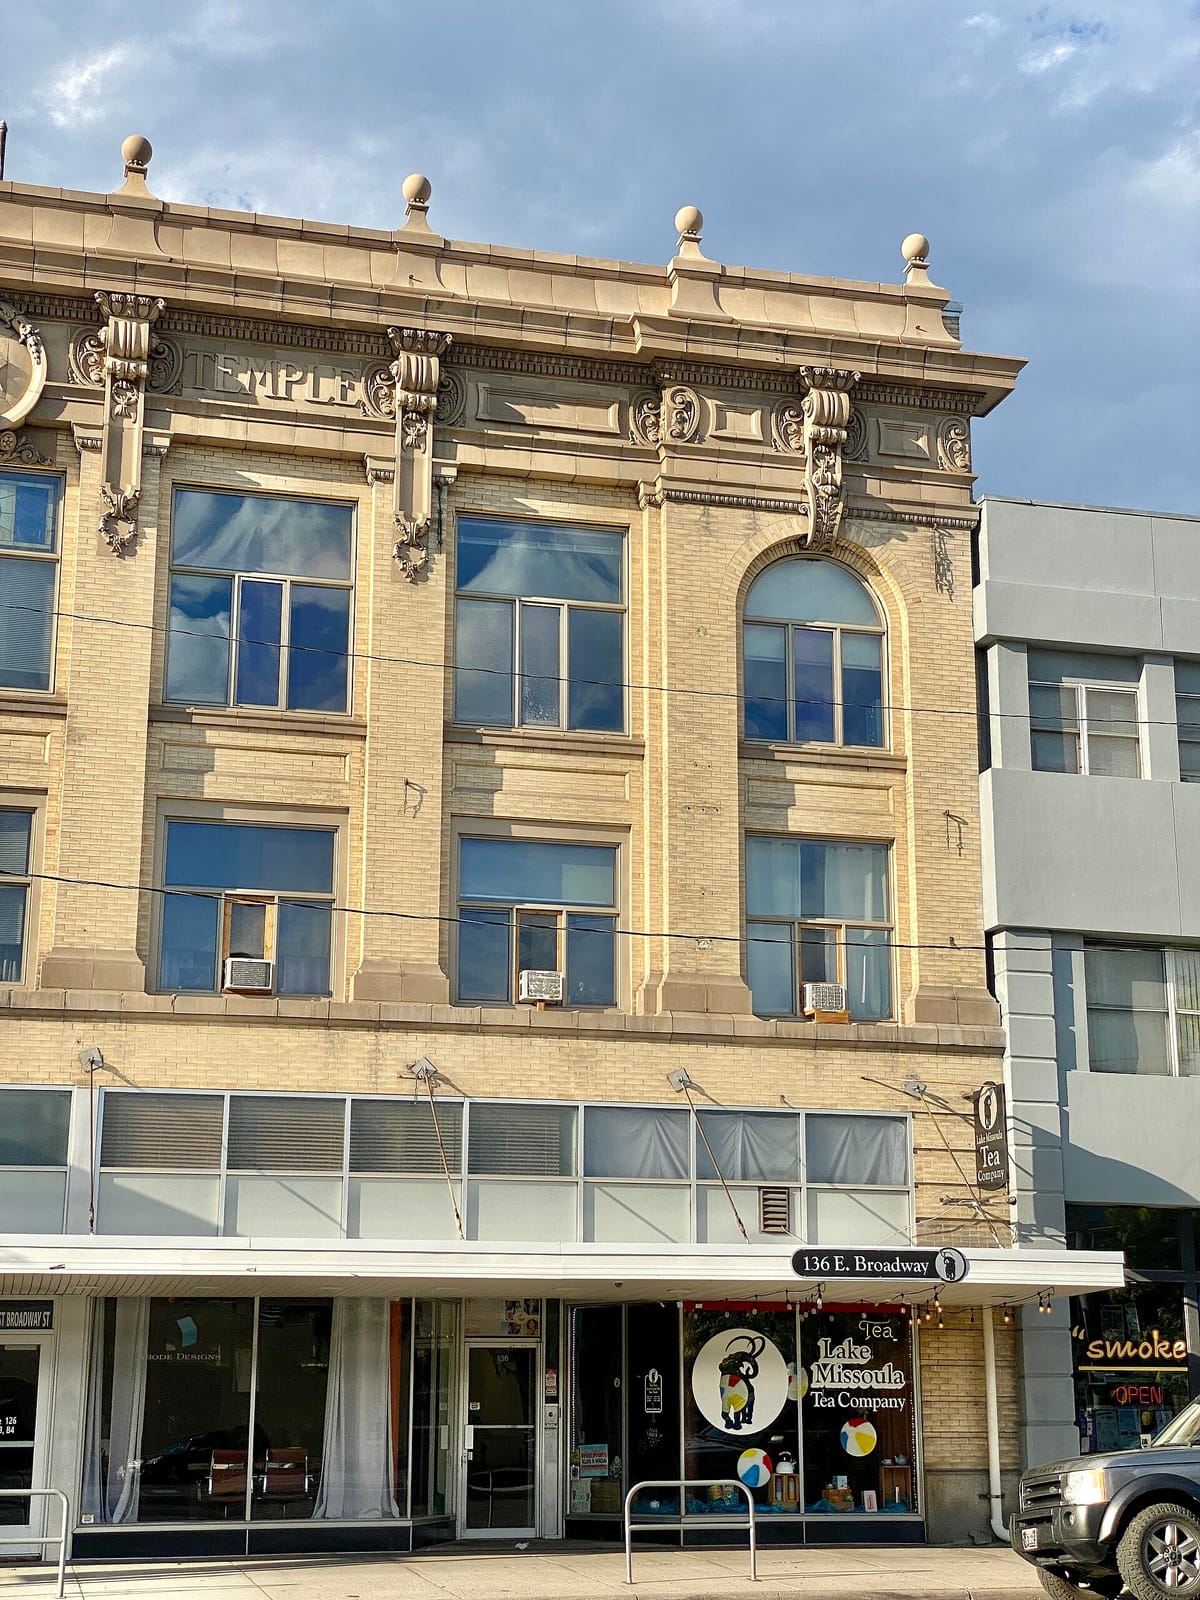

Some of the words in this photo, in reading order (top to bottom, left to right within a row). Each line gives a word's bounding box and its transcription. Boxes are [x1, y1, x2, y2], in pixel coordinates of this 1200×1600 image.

[184, 351, 362, 407] TEMPLE
[980, 1145, 1000, 1168] Tea
[977, 1168, 1004, 1182] Company
[802, 1255, 830, 1272] 136
[834, 1256, 850, 1272] E.
[855, 1255, 929, 1275] Broadway
[6, 1311, 42, 1327] BROADWAY
[42, 1311, 51, 1327] ST
[858, 1319, 894, 1341] Tea
[817, 1337, 872, 1365] Lake
[810, 1362, 905, 1389] Missoula
[810, 1391, 836, 1408] Tea
[838, 1391, 906, 1412] Company
[1115, 1386, 1164, 1405] OPEN
[5, 1416, 17, 1425] 126
